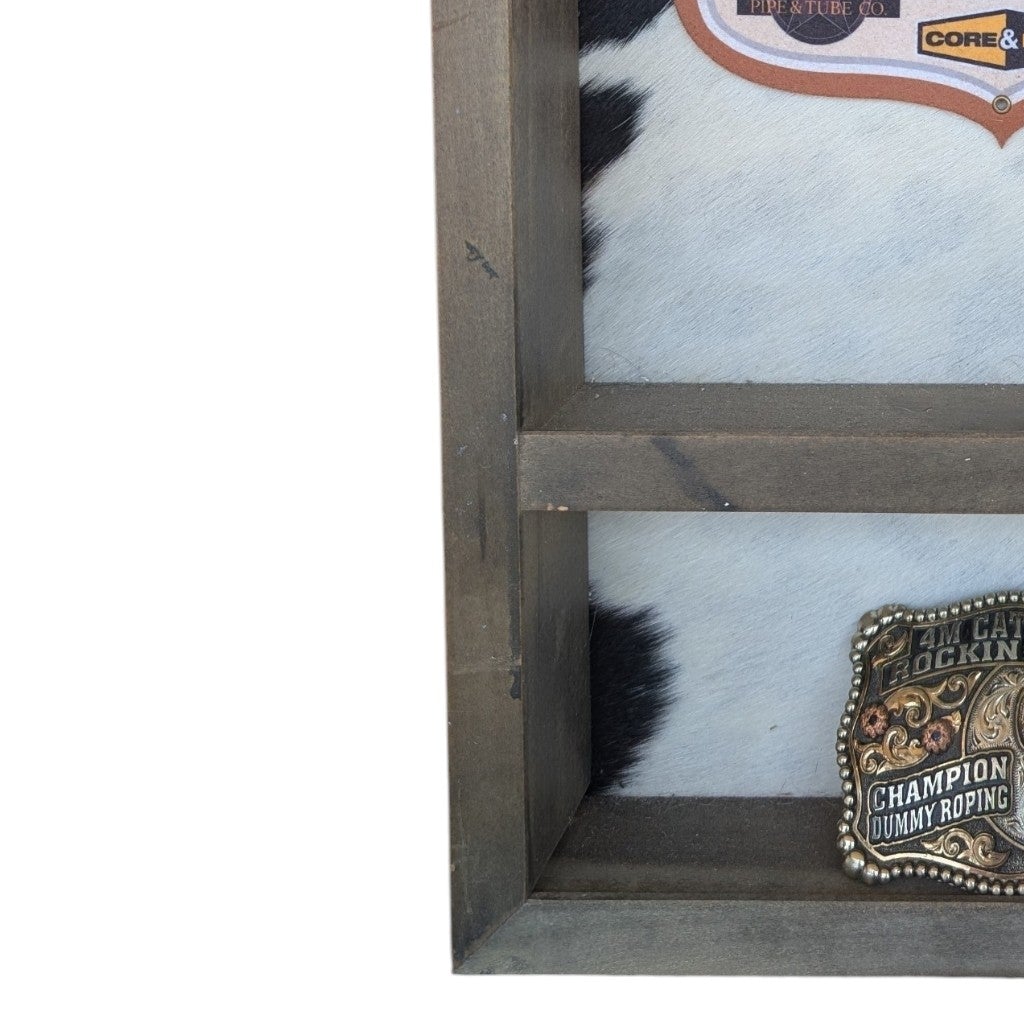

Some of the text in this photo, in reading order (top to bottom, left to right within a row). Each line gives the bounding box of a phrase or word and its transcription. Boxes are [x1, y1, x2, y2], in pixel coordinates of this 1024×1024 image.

[750, 0, 888, 16] PIPE & TUBE CO.
[925, 31, 998, 48] CORE
[999, 28, 1020, 50] &
[919, 620, 961, 649] 4M
[888, 639, 1020, 686] ROCKIN
[873, 756, 1008, 811] CHAMPION
[872, 784, 1009, 840] DUMMY ROPING
